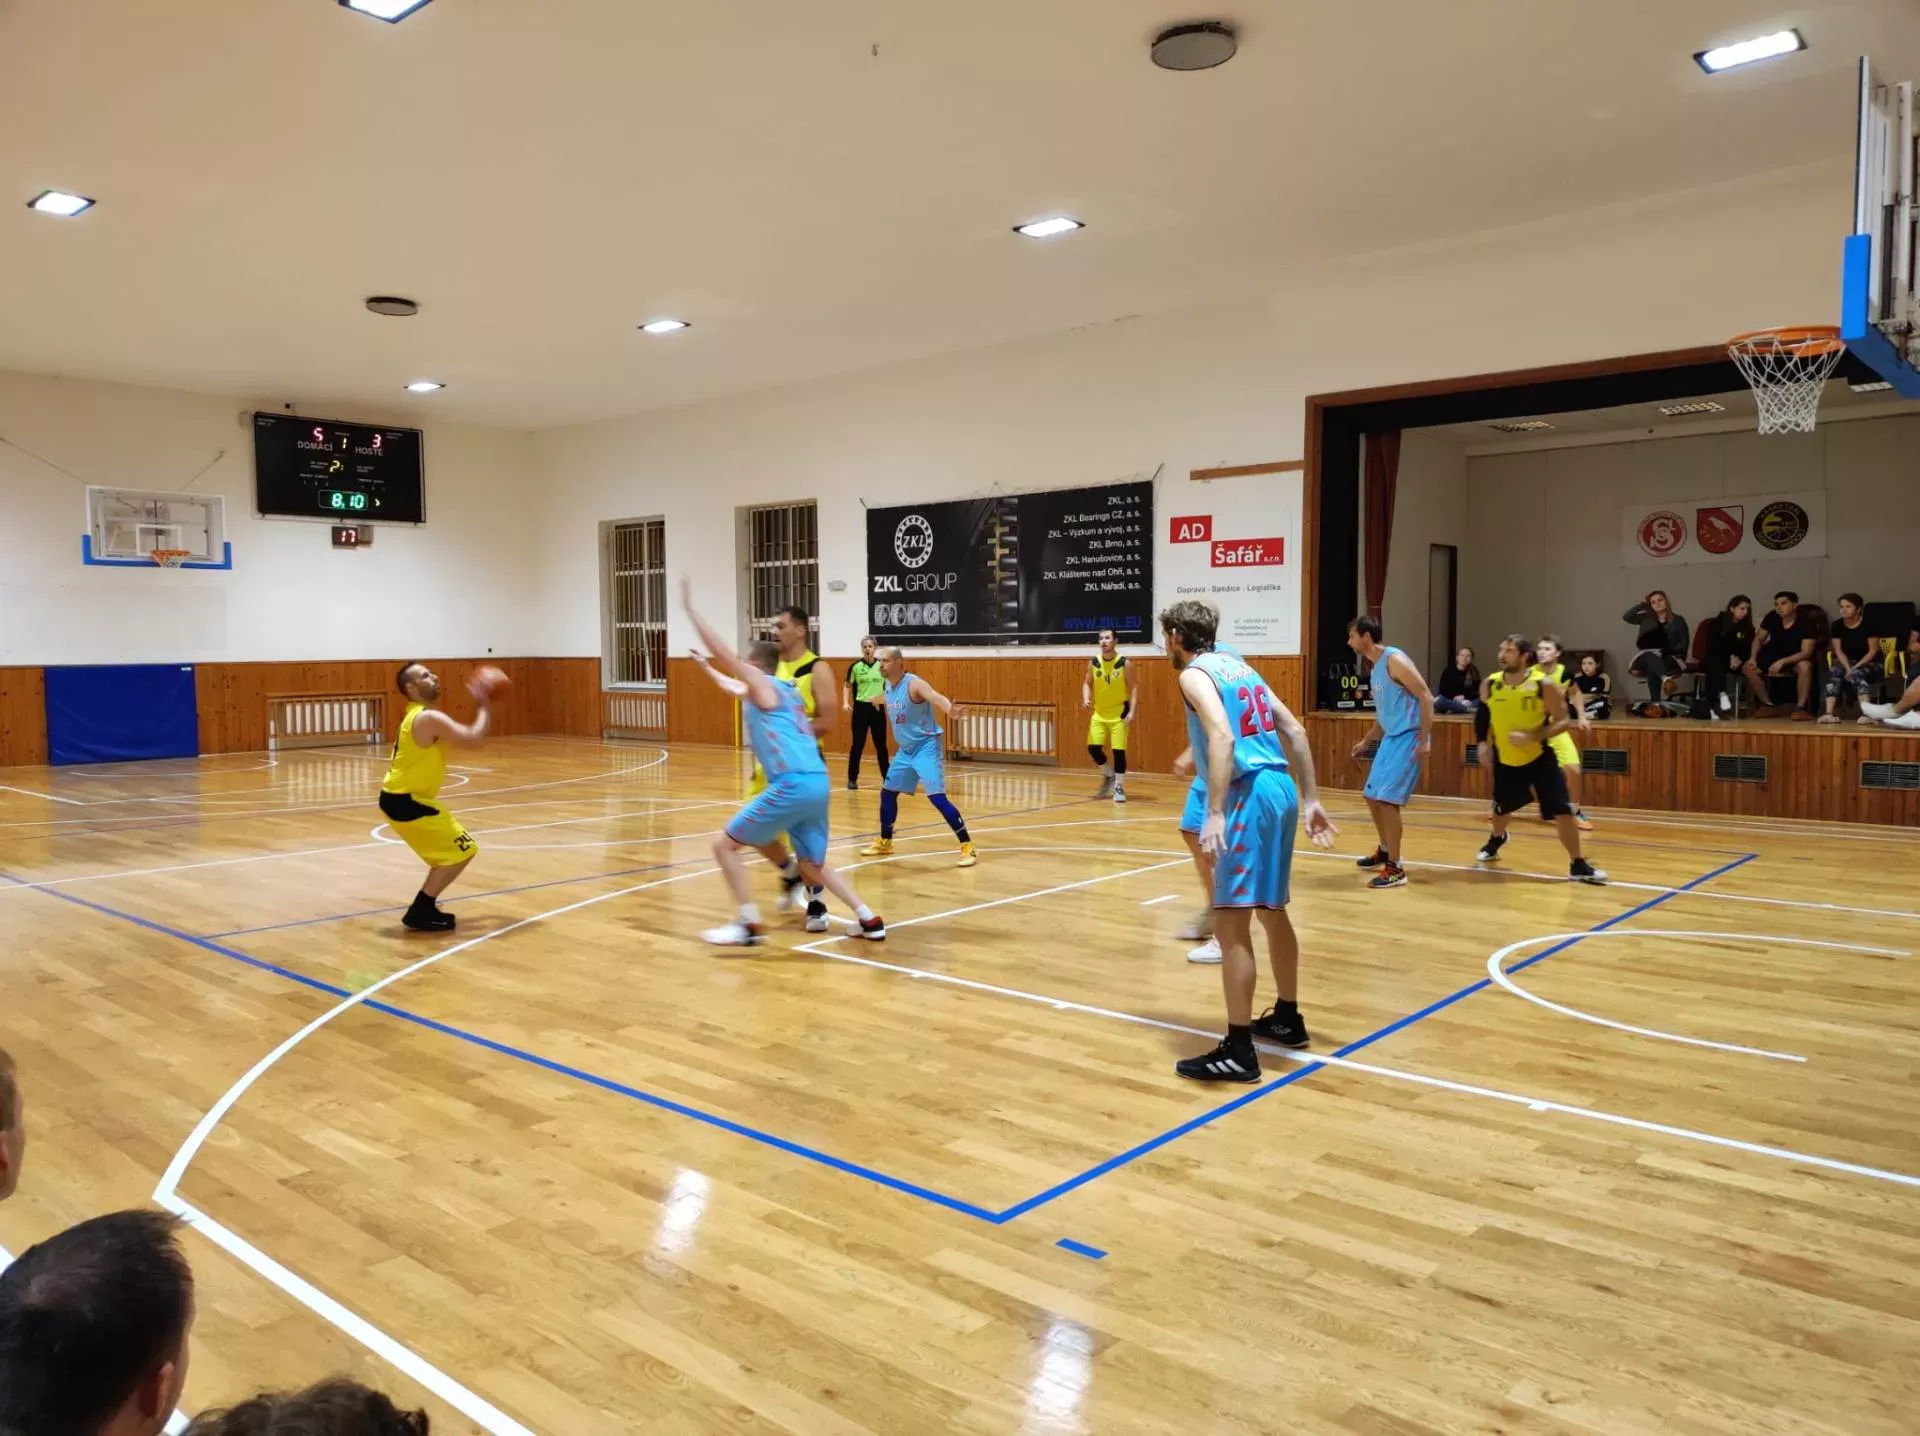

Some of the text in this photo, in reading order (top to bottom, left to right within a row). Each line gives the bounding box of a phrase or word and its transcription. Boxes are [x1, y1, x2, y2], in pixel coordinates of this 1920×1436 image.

[313, 427, 323, 441] 5
[372, 434, 382, 448] 3
[1063, 514, 1077, 524] ZKL
[1080, 513, 1110, 522] Bearings
[340, 530, 356, 543] 17
[1047, 530, 1062, 539] ZKL
[1178, 523, 1205, 540] AD
[902, 535, 926, 548] ZKL
[1089, 541, 1103, 549] ZKL
[1066, 555, 1080, 565] ZKL
[1215, 543, 1263, 564] Šafář
[1043, 571, 1057, 580] ZKL
[1092, 568, 1106, 577] nad
[874, 572, 957, 592] ZKL GROUP
[1084, 583, 1099, 592] ZKL
[1176, 586, 1206, 596] Doprava
[1212, 585, 1240, 594] Spedice
[1246, 584, 1281, 593] Logistika
[1238, 685, 1275, 737] 26
